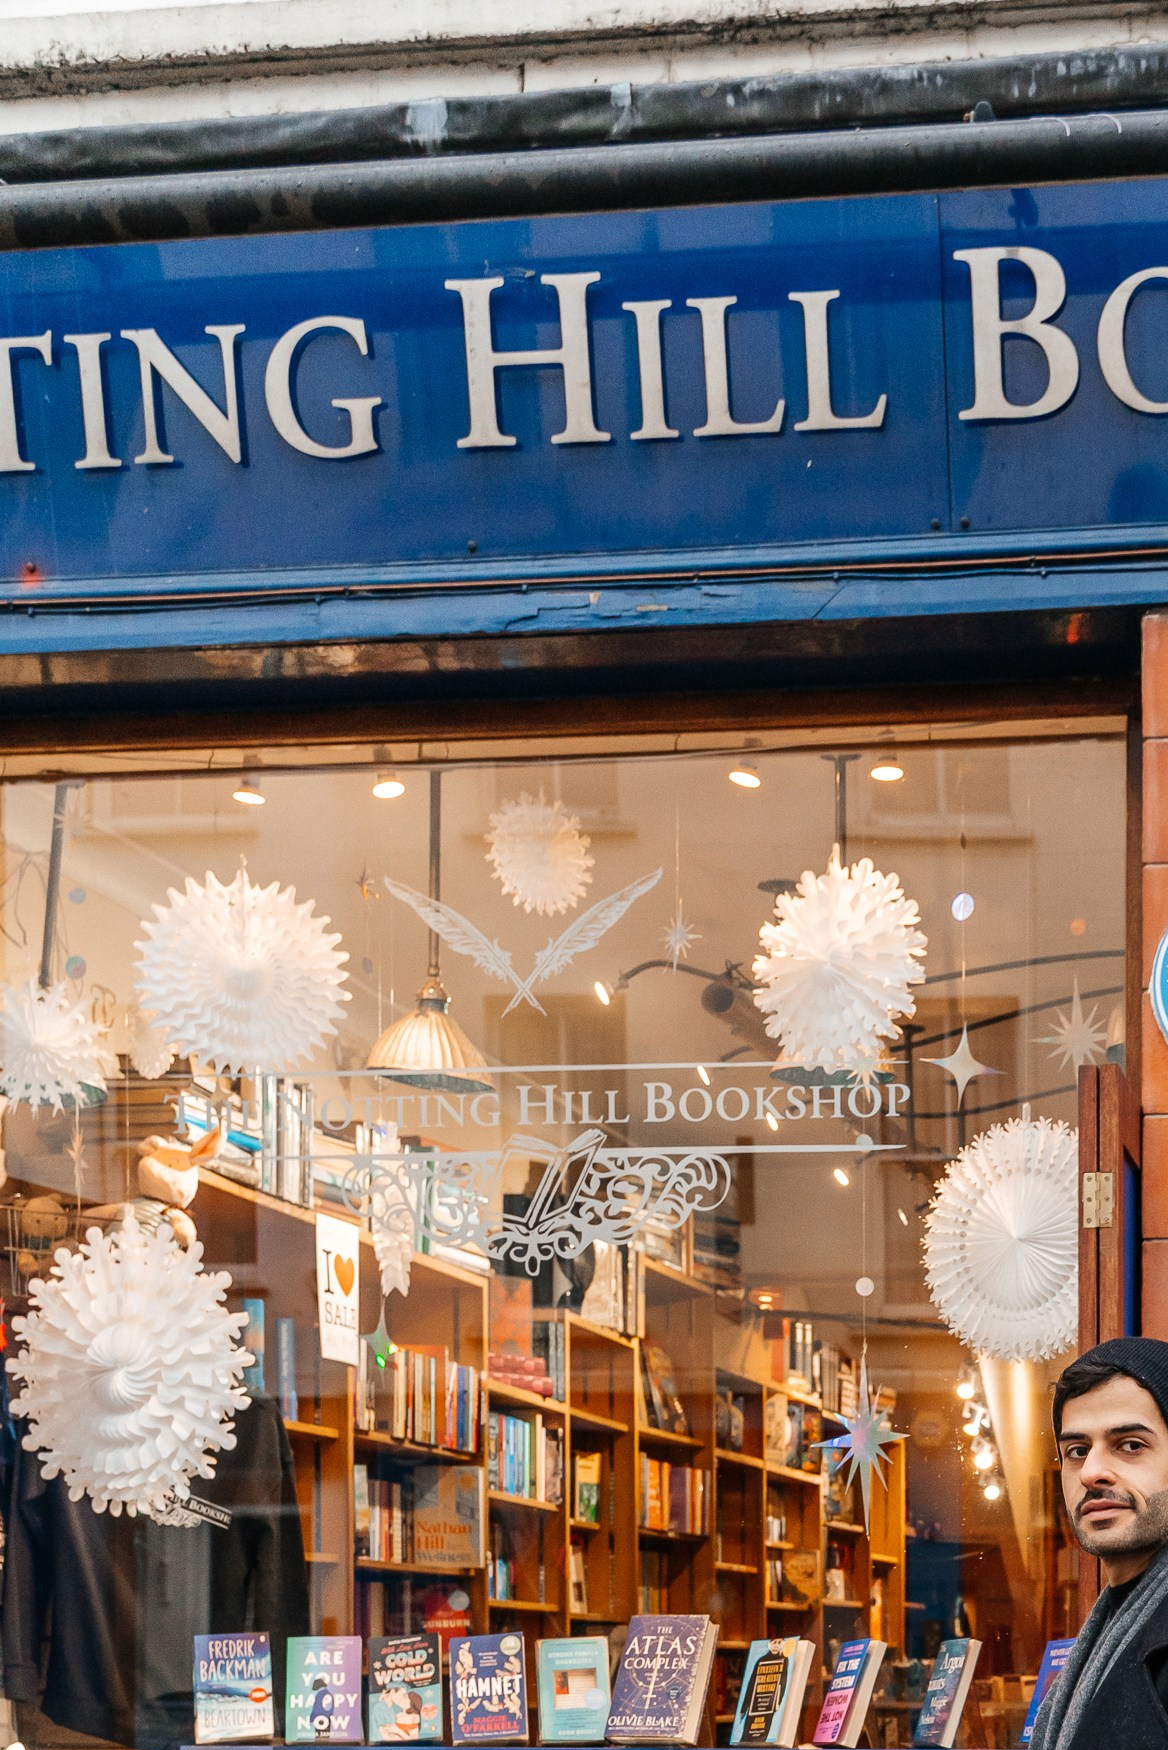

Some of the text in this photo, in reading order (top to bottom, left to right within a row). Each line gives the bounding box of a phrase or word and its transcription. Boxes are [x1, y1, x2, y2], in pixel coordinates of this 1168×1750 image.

[444, 271, 887, 447] HILL
[516, 1084, 630, 1127] HILL
[643, 1081, 912, 1124] BOOKSHOP
[322, 1249, 335, 1294] I
[416, 1536, 445, 1549] Hill
[656, 1626, 673, 1634] THE
[208, 1639, 255, 1659] FREDRIK
[625, 1636, 698, 1655] ATLAS
[304, 1651, 343, 1665] ARE
[385, 1649, 427, 1669] COLD
[624, 1657, 689, 1670] COMPLEX
[200, 1658, 266, 1682] BACKMAN
[302, 1672, 345, 1686] YOU
[374, 1663, 435, 1686] WORLD
[457, 1674, 522, 1698] HAMNET
[290, 1693, 358, 1708] HAPPY
[204, 1707, 265, 1728] BEARTOWN
[297, 1715, 350, 1730] NOW
[608, 1714, 644, 1726] OLIVIE
[645, 1715, 680, 1727] BLAKE
